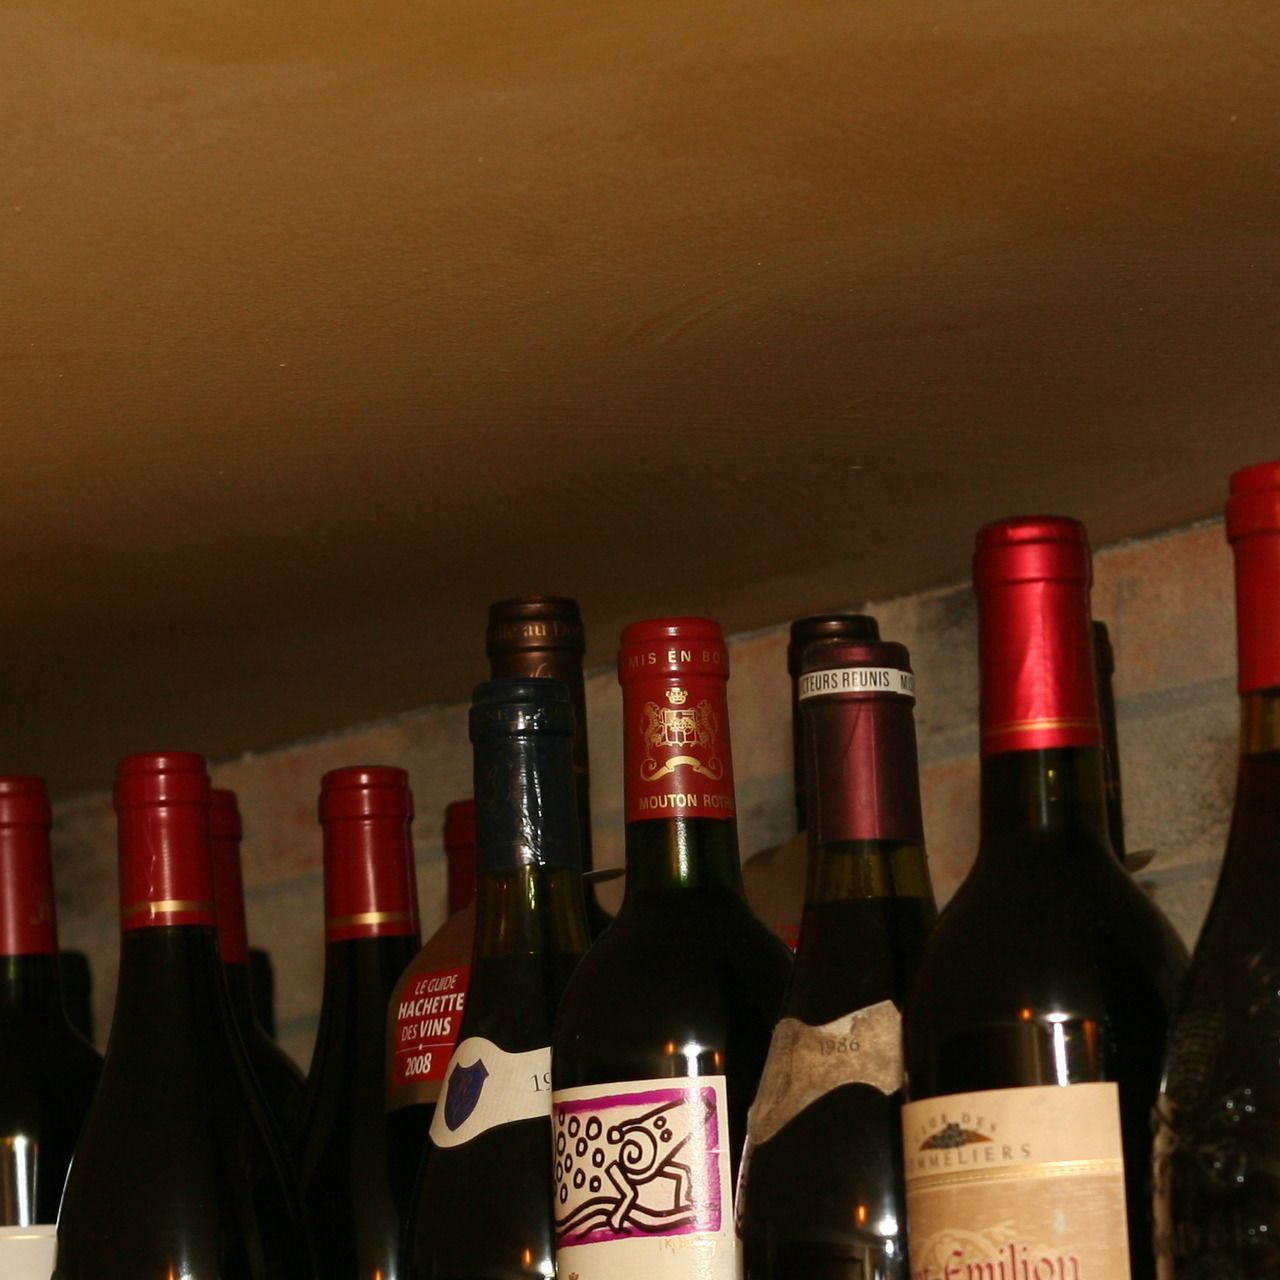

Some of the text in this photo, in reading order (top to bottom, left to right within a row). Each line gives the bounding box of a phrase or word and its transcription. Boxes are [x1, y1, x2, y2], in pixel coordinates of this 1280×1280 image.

[523, 623, 547, 637] au
[628, 652, 657, 669] MIS
[667, 650, 692, 664] EN
[639, 793, 698, 810] MOUTON
[414, 974, 458, 995] LE GUIDE
[398, 992, 465, 1020] HACHETTE
[401, 1016, 452, 1042] DES VINS
[405, 1052, 432, 1077] 2008
